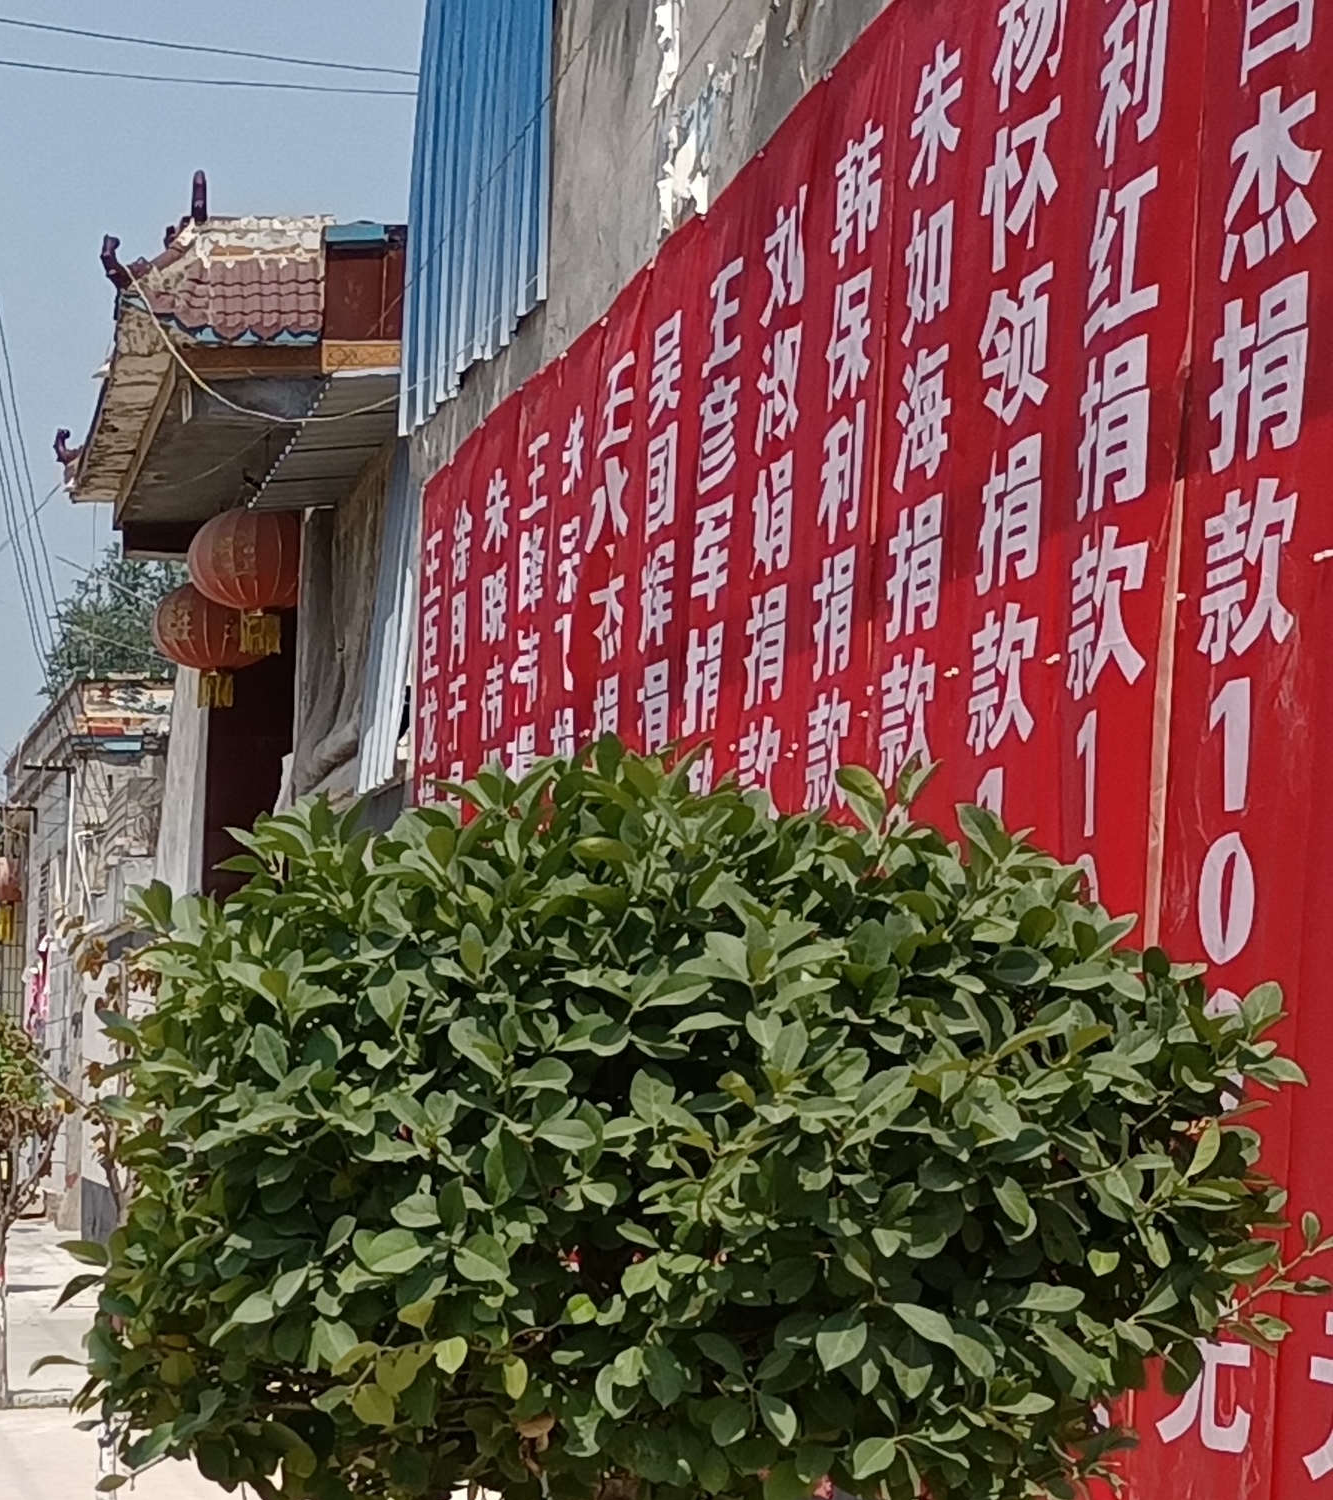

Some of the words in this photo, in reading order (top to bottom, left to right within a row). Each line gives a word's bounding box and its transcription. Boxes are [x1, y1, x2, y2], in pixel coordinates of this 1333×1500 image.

[481, 468, 510, 768] 朱晓伟
[803, 119, 887, 810] 韩保利捐款
